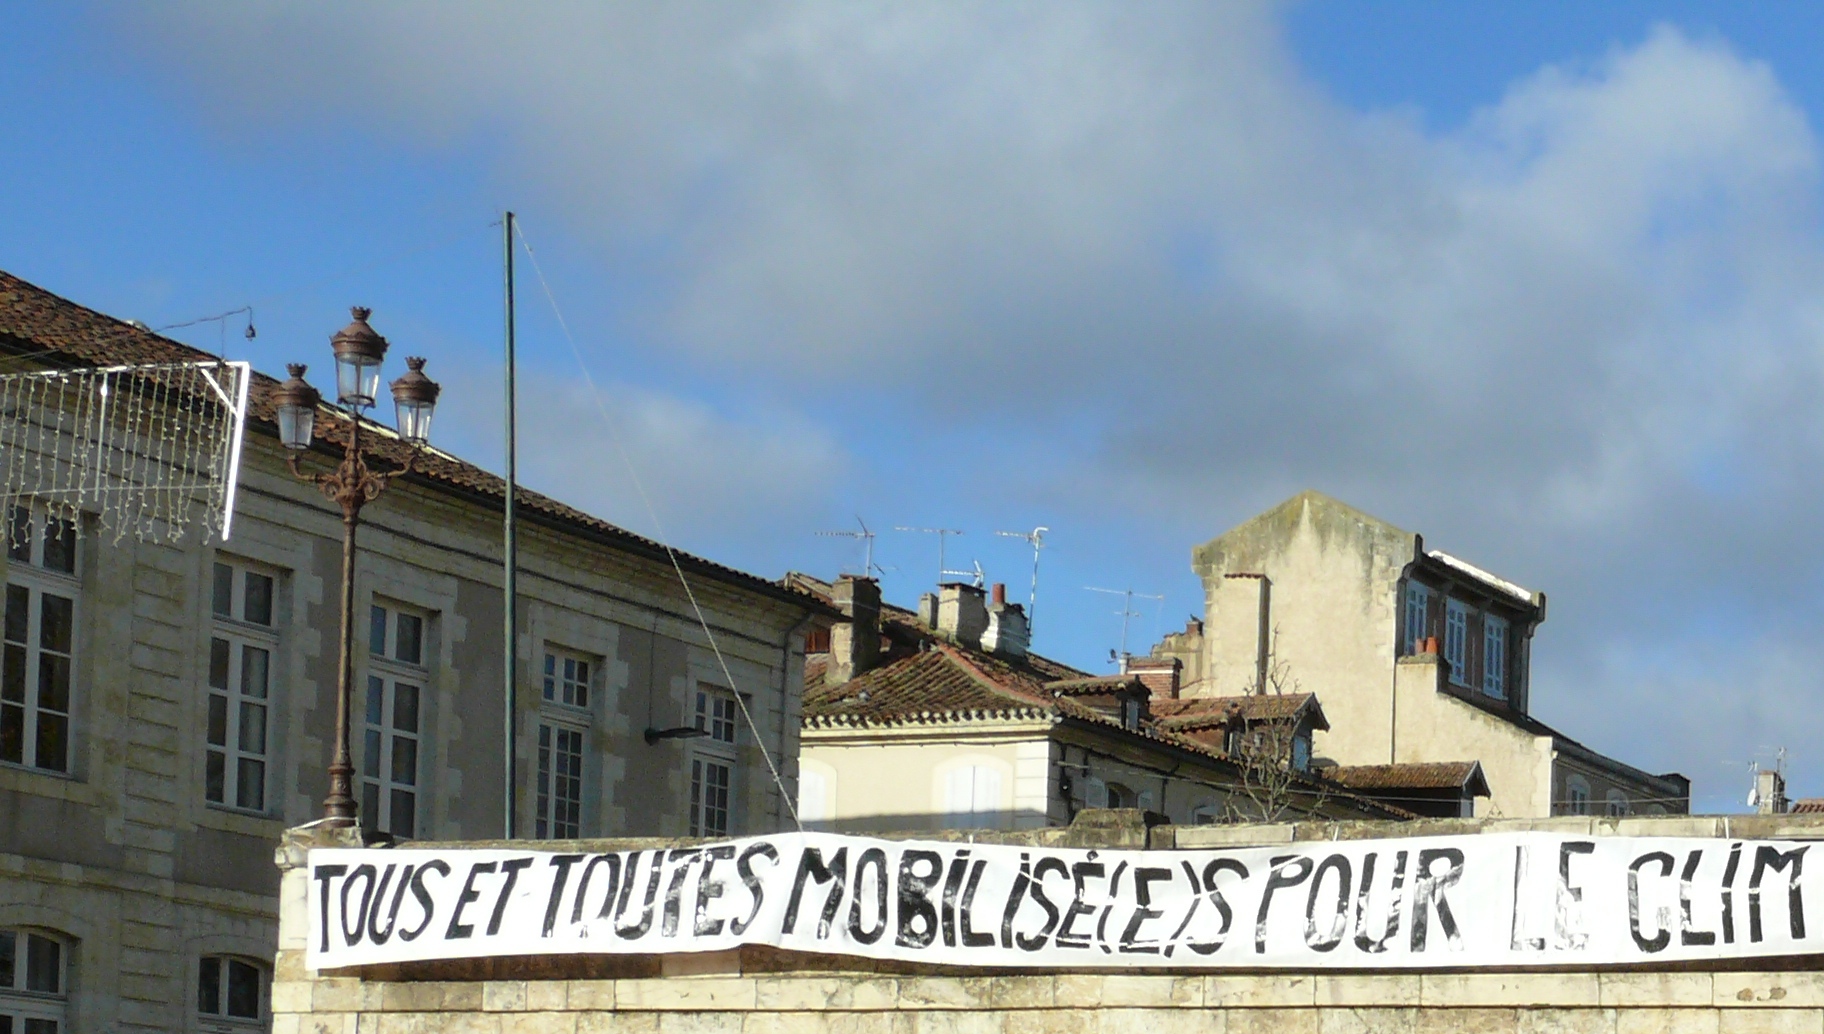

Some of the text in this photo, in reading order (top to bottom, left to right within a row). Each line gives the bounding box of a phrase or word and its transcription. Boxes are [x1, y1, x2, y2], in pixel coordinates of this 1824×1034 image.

[315, 859, 452, 953] TOUS
[445, 857, 535, 939] ET
[541, 841, 780, 940] TOUTES
[1255, 847, 1466, 954] POUR
[1510, 841, 1596, 951] LE
